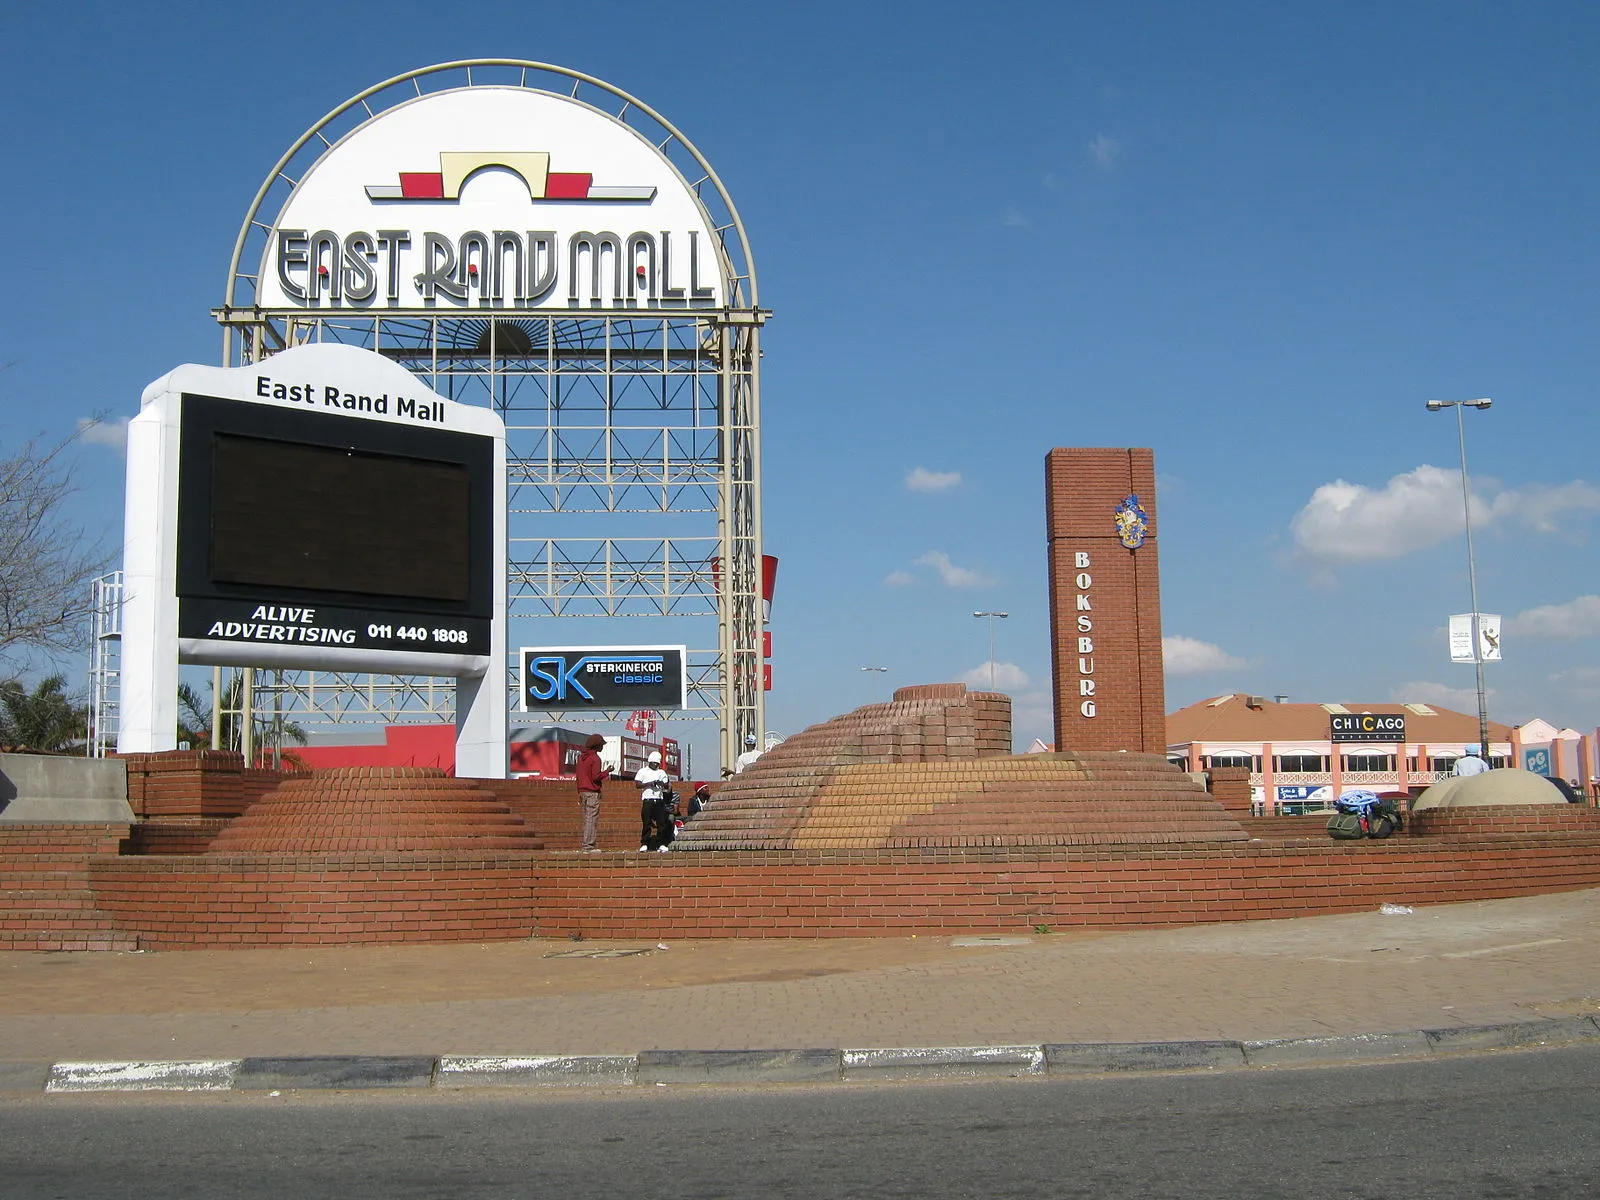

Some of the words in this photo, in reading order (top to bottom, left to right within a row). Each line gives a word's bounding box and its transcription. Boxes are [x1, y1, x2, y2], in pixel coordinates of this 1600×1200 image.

[276, 228, 411, 301] EAST
[414, 230, 558, 301] RAND
[567, 230, 715, 301] MALL
[256, 376, 315, 404] East
[324, 386, 388, 415] Rand
[396, 396, 445, 423] Mall
[251, 605, 316, 624] ALIVE
[208, 621, 357, 645] ADVERTISING
[367, 623, 392, 640] 011
[396, 625, 428, 642] 440
[431, 627, 469, 644] 1808
[1075, 552, 1097, 718] BOKSBURG
[613, 673, 663, 684] classic
[1332, 716, 1404, 732] CHICAGO
